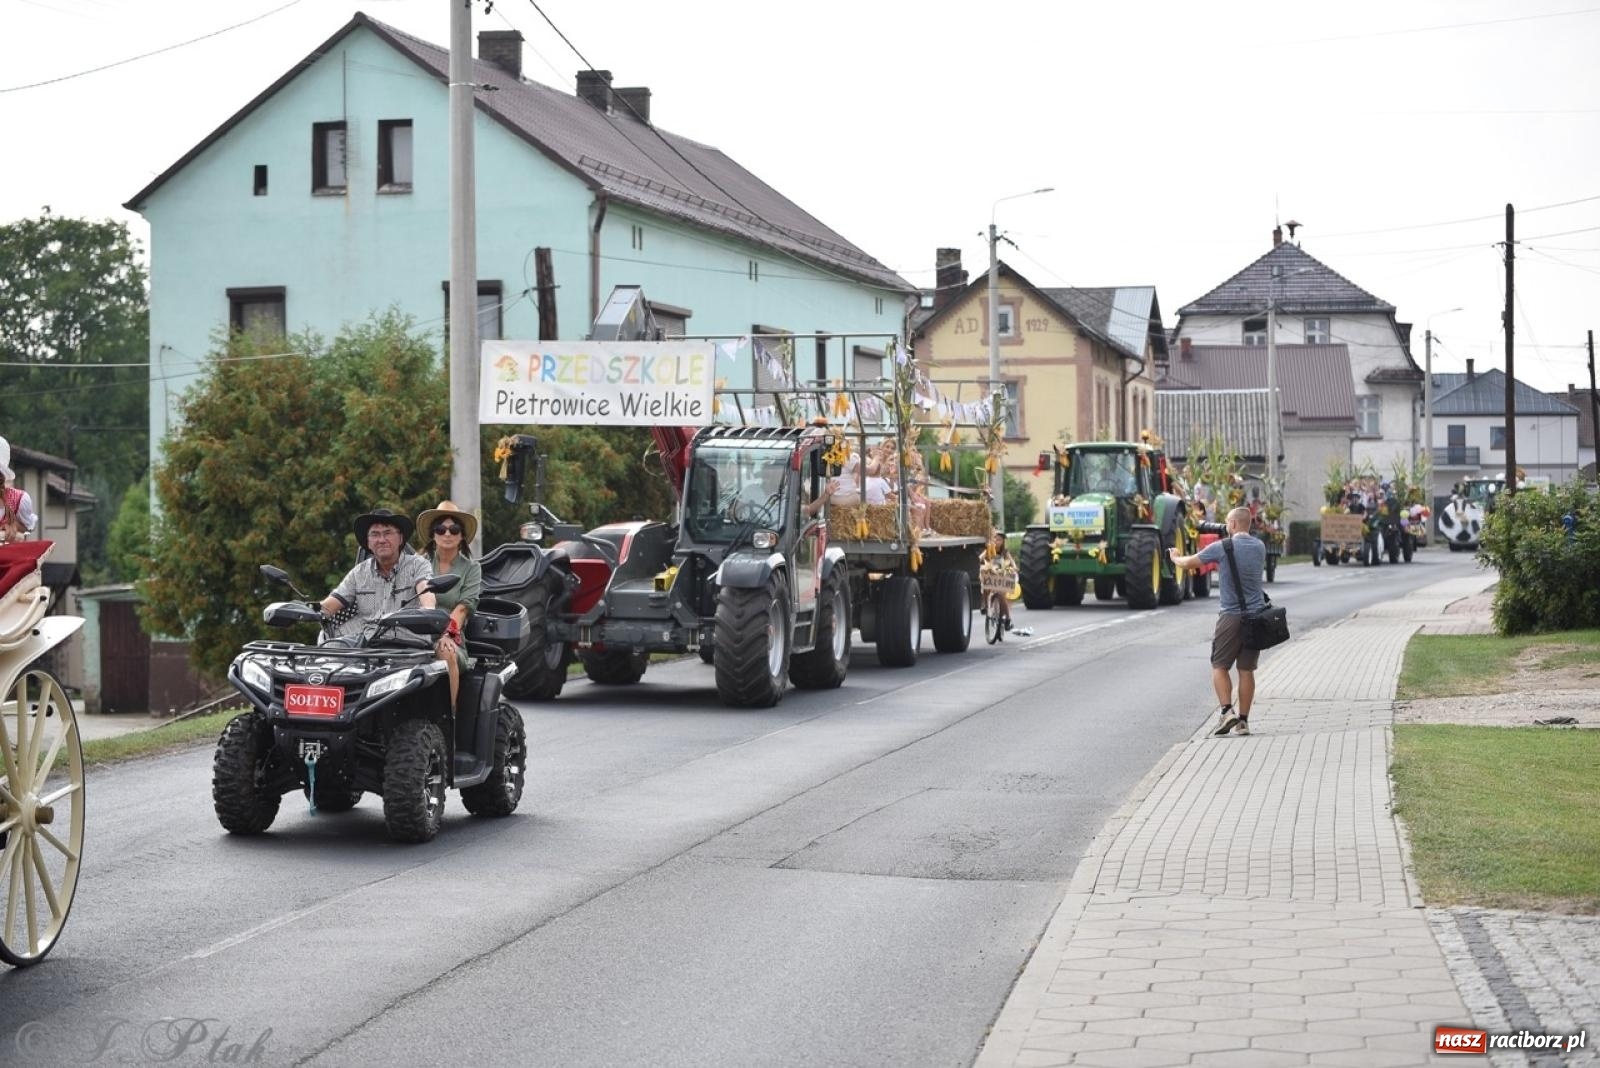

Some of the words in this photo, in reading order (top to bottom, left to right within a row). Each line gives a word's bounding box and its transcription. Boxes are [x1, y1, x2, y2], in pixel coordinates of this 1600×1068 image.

[528, 354, 704, 385] PRZEDSZKOLE
[495, 389, 610, 416] Pietrowice
[619, 391, 702, 417] Wielkie
